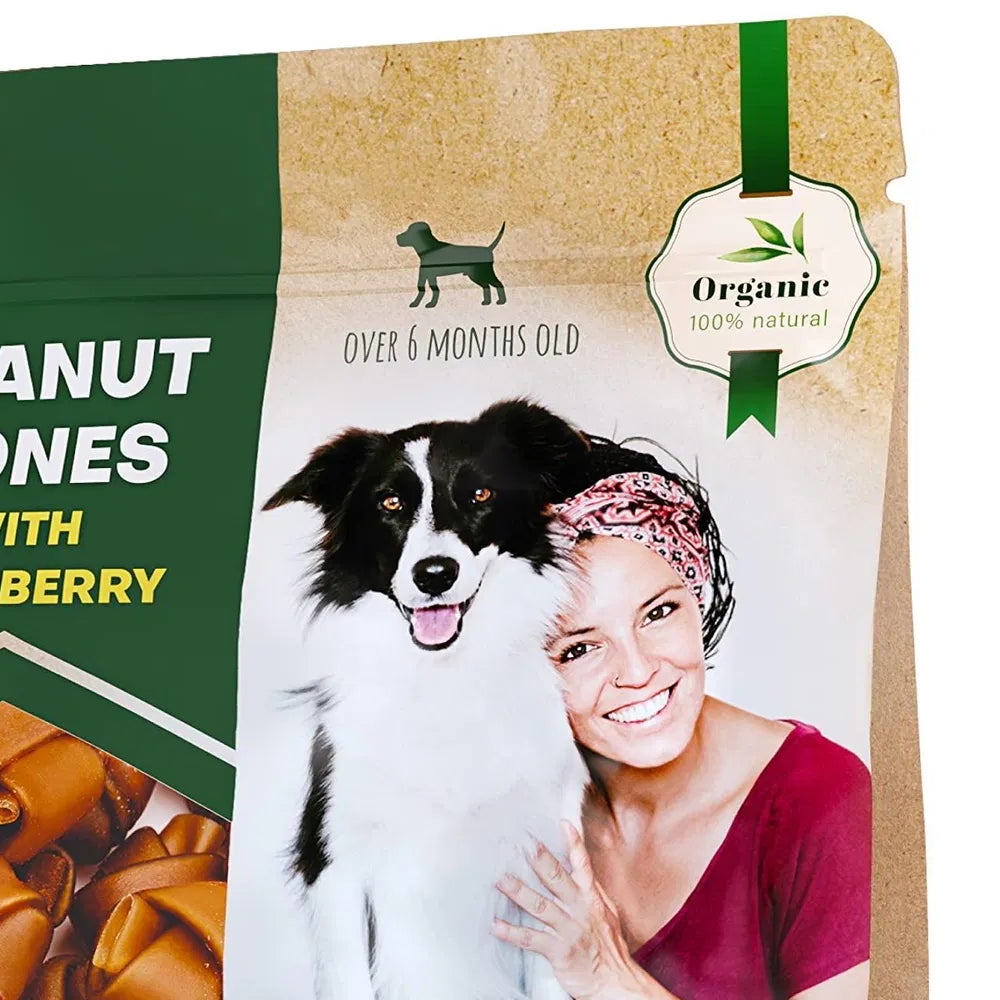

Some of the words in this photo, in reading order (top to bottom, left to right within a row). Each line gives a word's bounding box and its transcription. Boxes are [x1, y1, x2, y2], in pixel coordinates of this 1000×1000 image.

[692, 271, 830, 308] Organic
[689, 312, 744, 331] 100%
[751, 308, 829, 330] natural
[344, 331, 397, 364] OVER
[406, 324, 418, 361] 6
[427, 323, 527, 360] MONTHS
[535, 323, 580, 356] OLD
